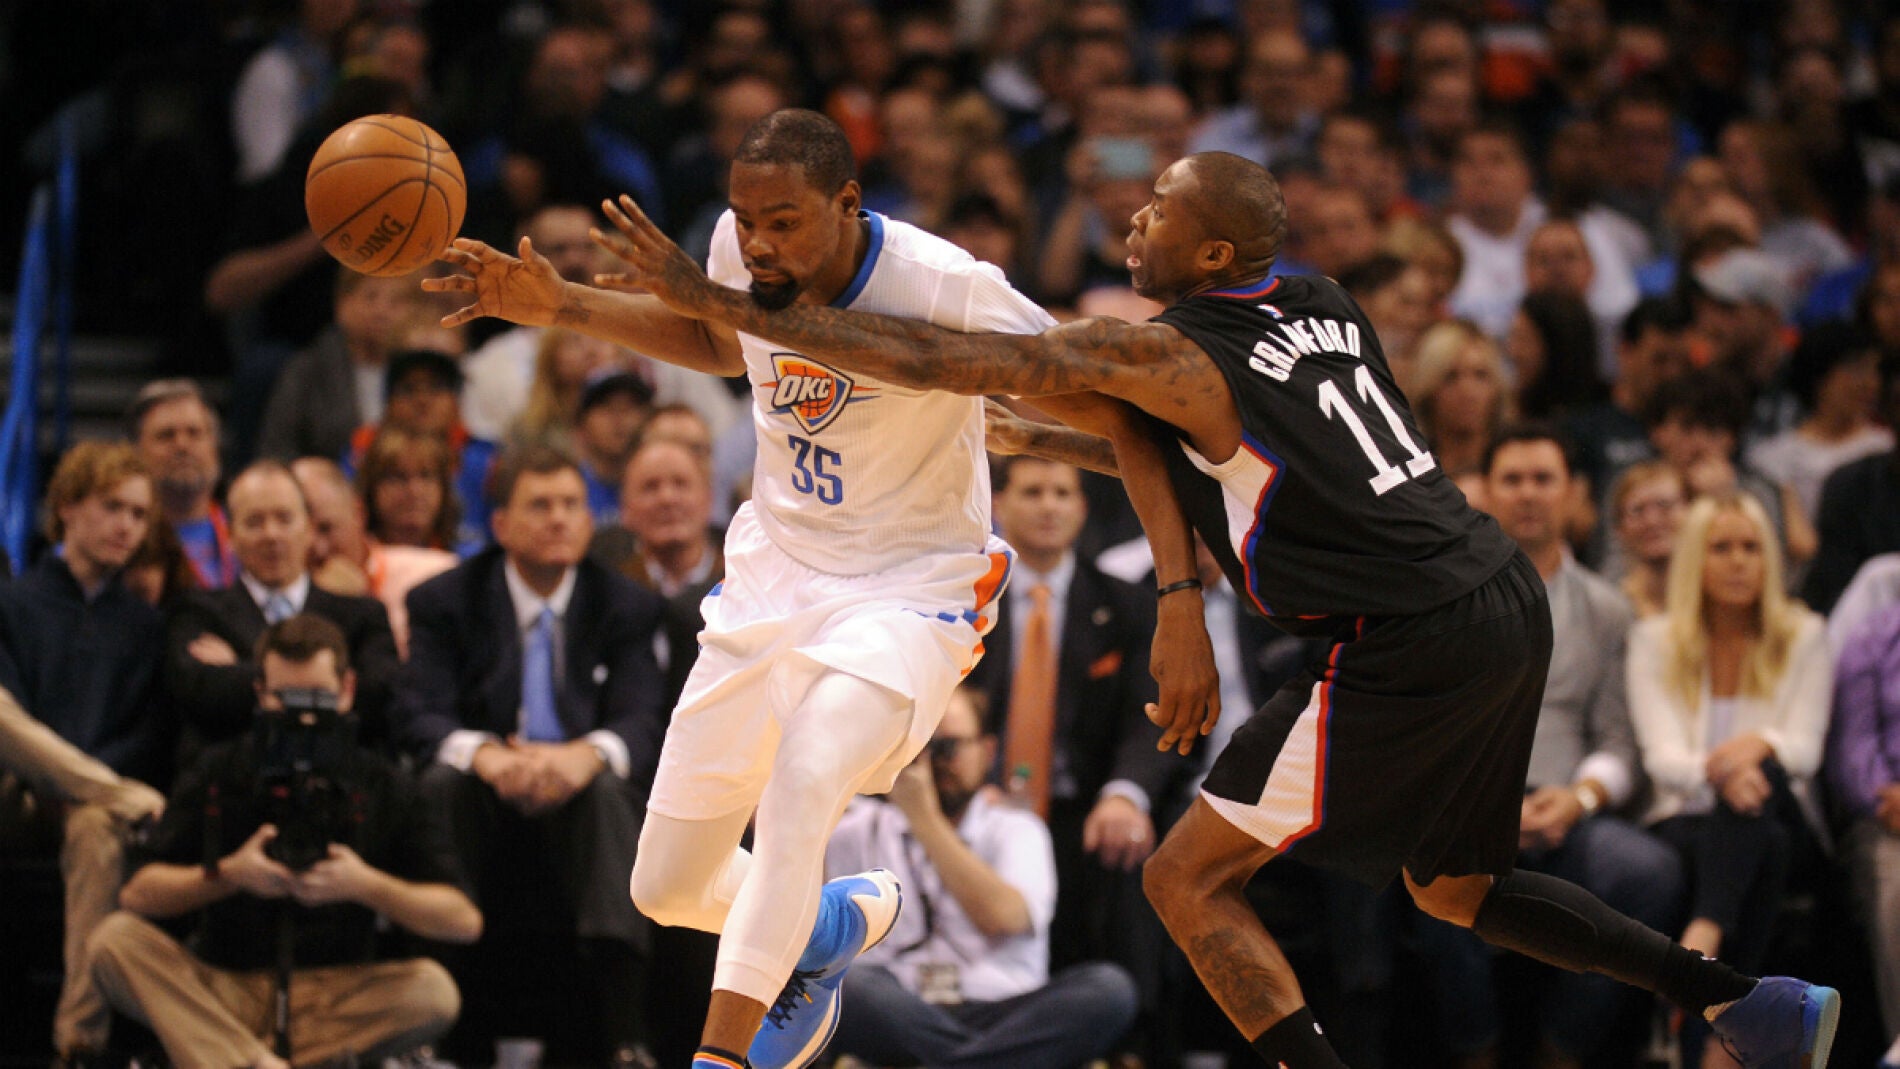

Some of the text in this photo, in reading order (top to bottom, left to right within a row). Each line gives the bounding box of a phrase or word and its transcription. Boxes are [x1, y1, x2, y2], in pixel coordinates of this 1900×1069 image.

[774, 375, 832, 407] OKC
[1318, 364, 1436, 496] 11
[787, 433, 843, 505] 35
